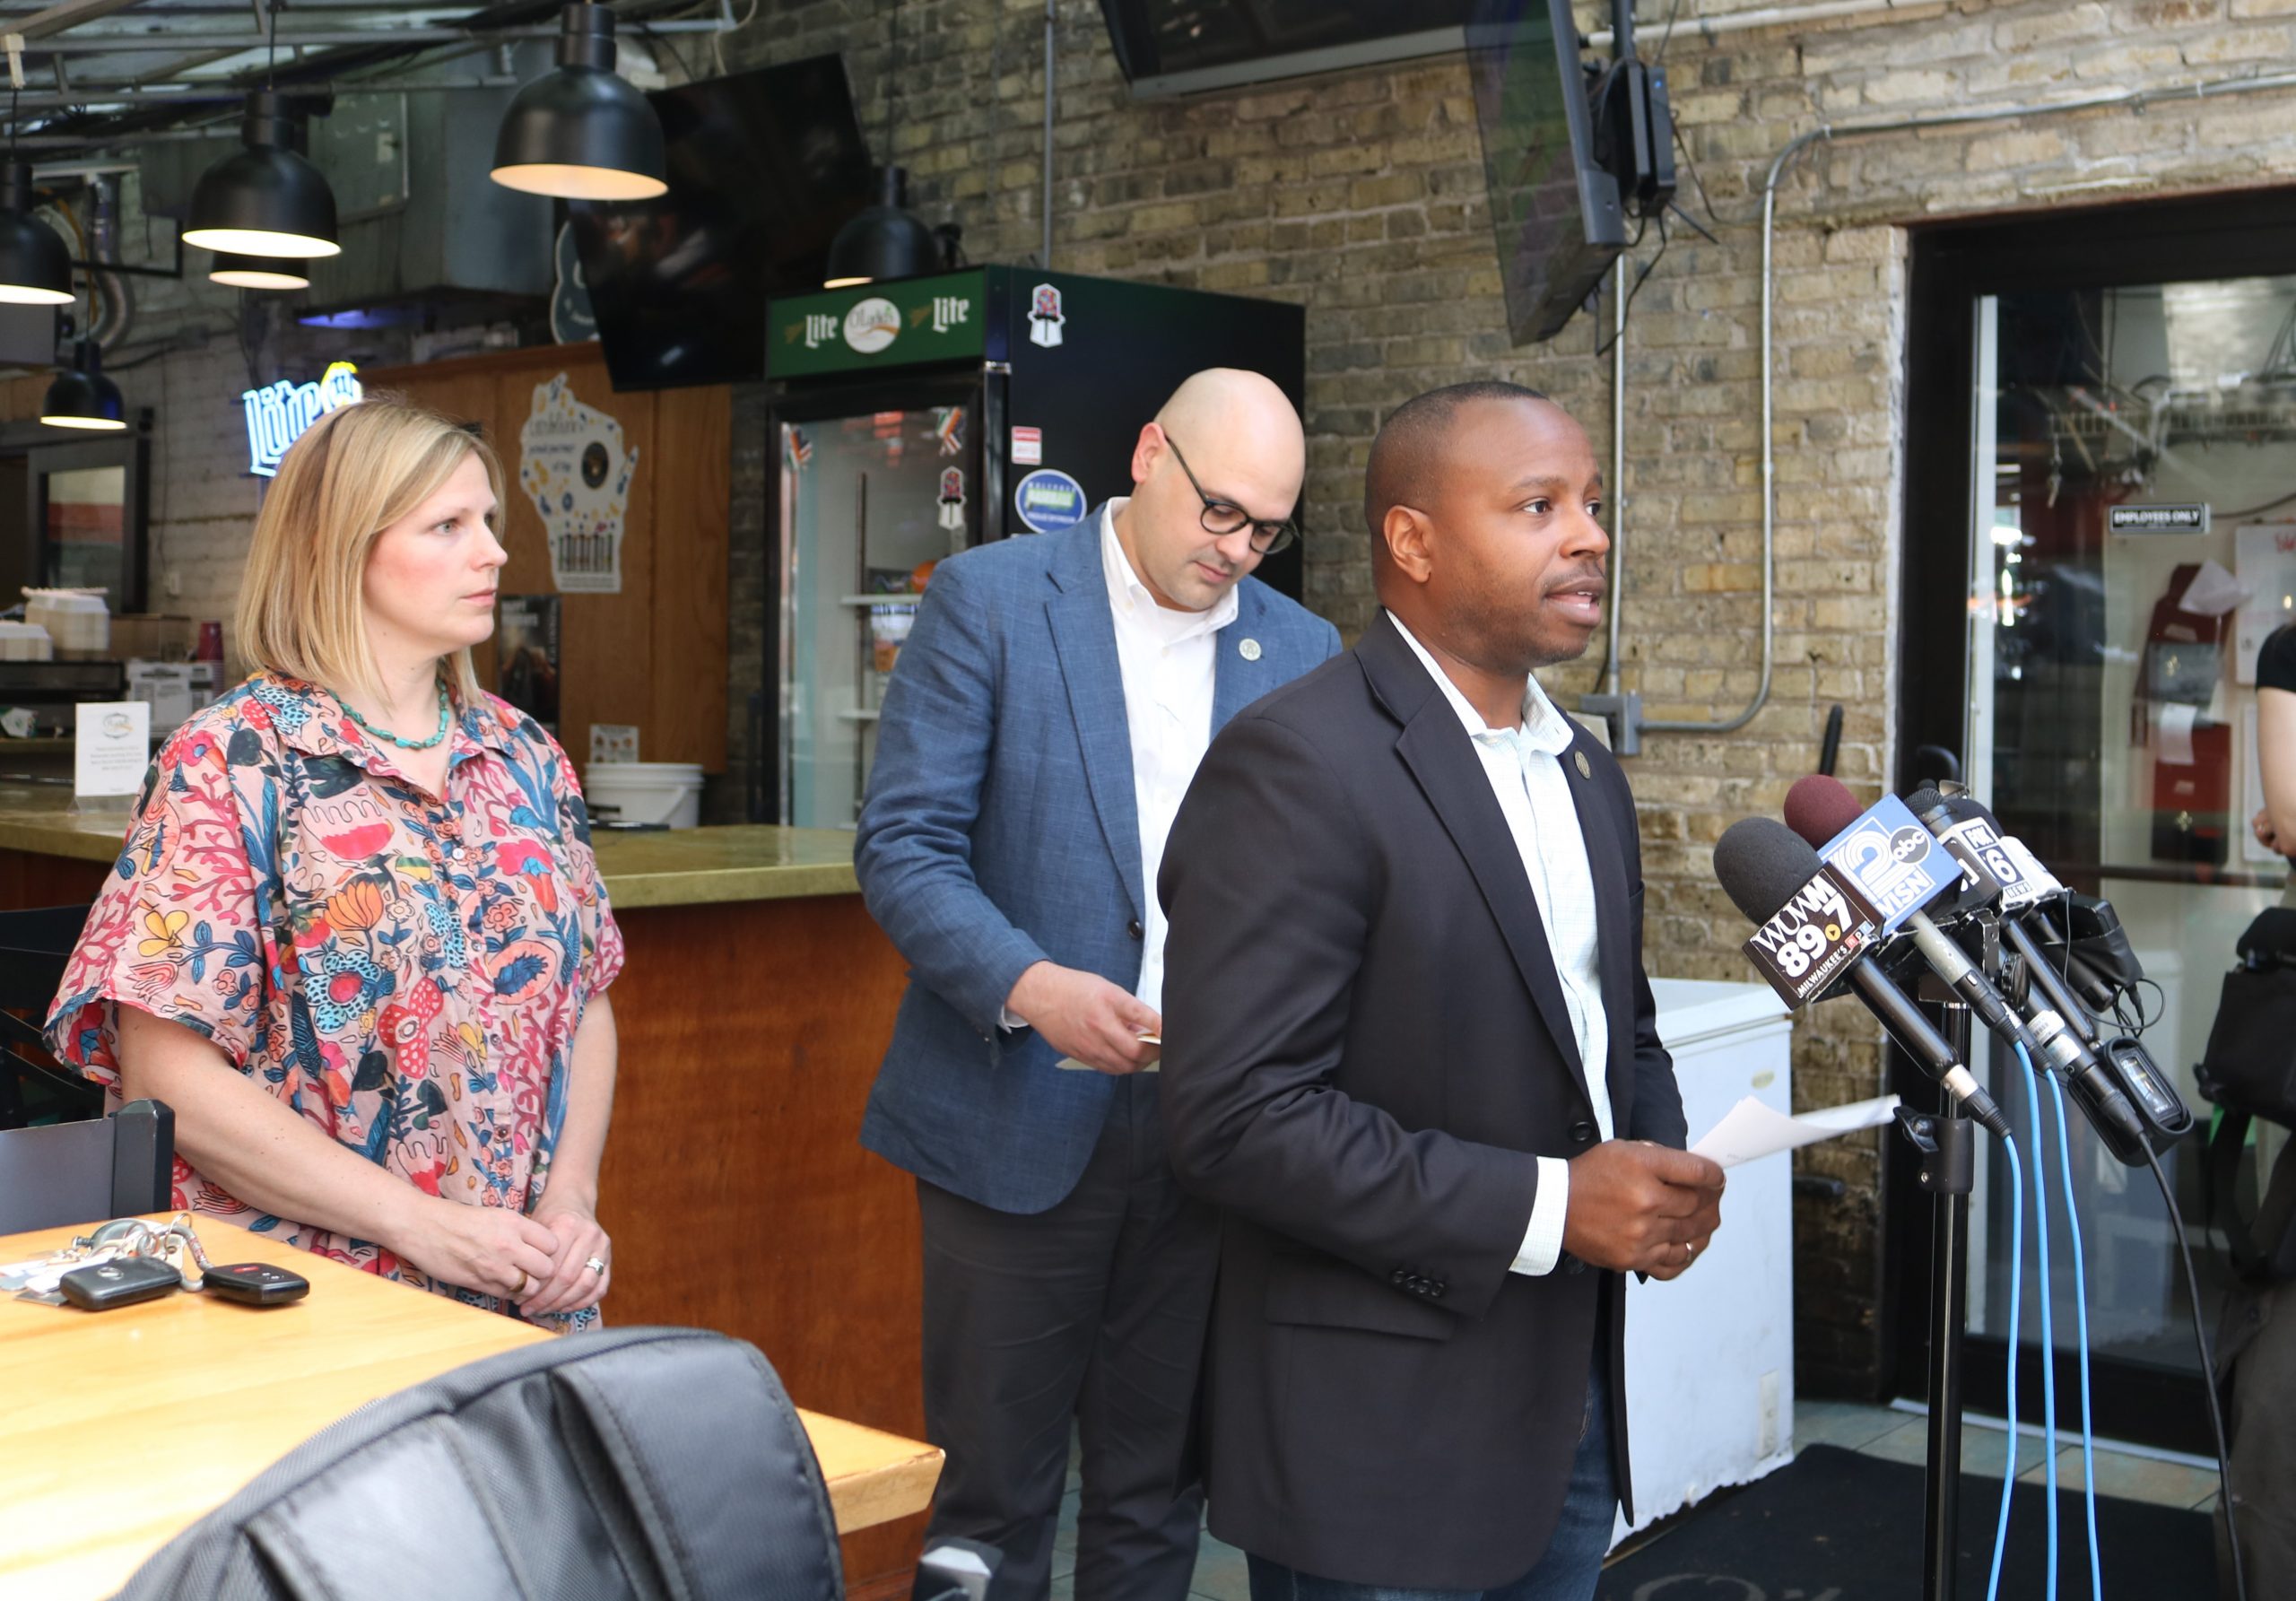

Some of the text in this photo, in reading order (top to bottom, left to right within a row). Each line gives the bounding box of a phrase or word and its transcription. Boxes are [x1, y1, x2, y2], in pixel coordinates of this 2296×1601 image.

[804, 314, 839, 349] Lite
[933, 296, 970, 334] Lite
[2114, 510, 2199, 524] EMPLOYEES ONLY
[1892, 831, 1926, 861] abc
[1963, 825, 1996, 848] FOX
[1986, 848, 2017, 883] 6
[2005, 881, 2032, 899] NEWS
[1753, 874, 1838, 953] WUWM
[1796, 944, 1848, 999] MILWAUKEE'S
